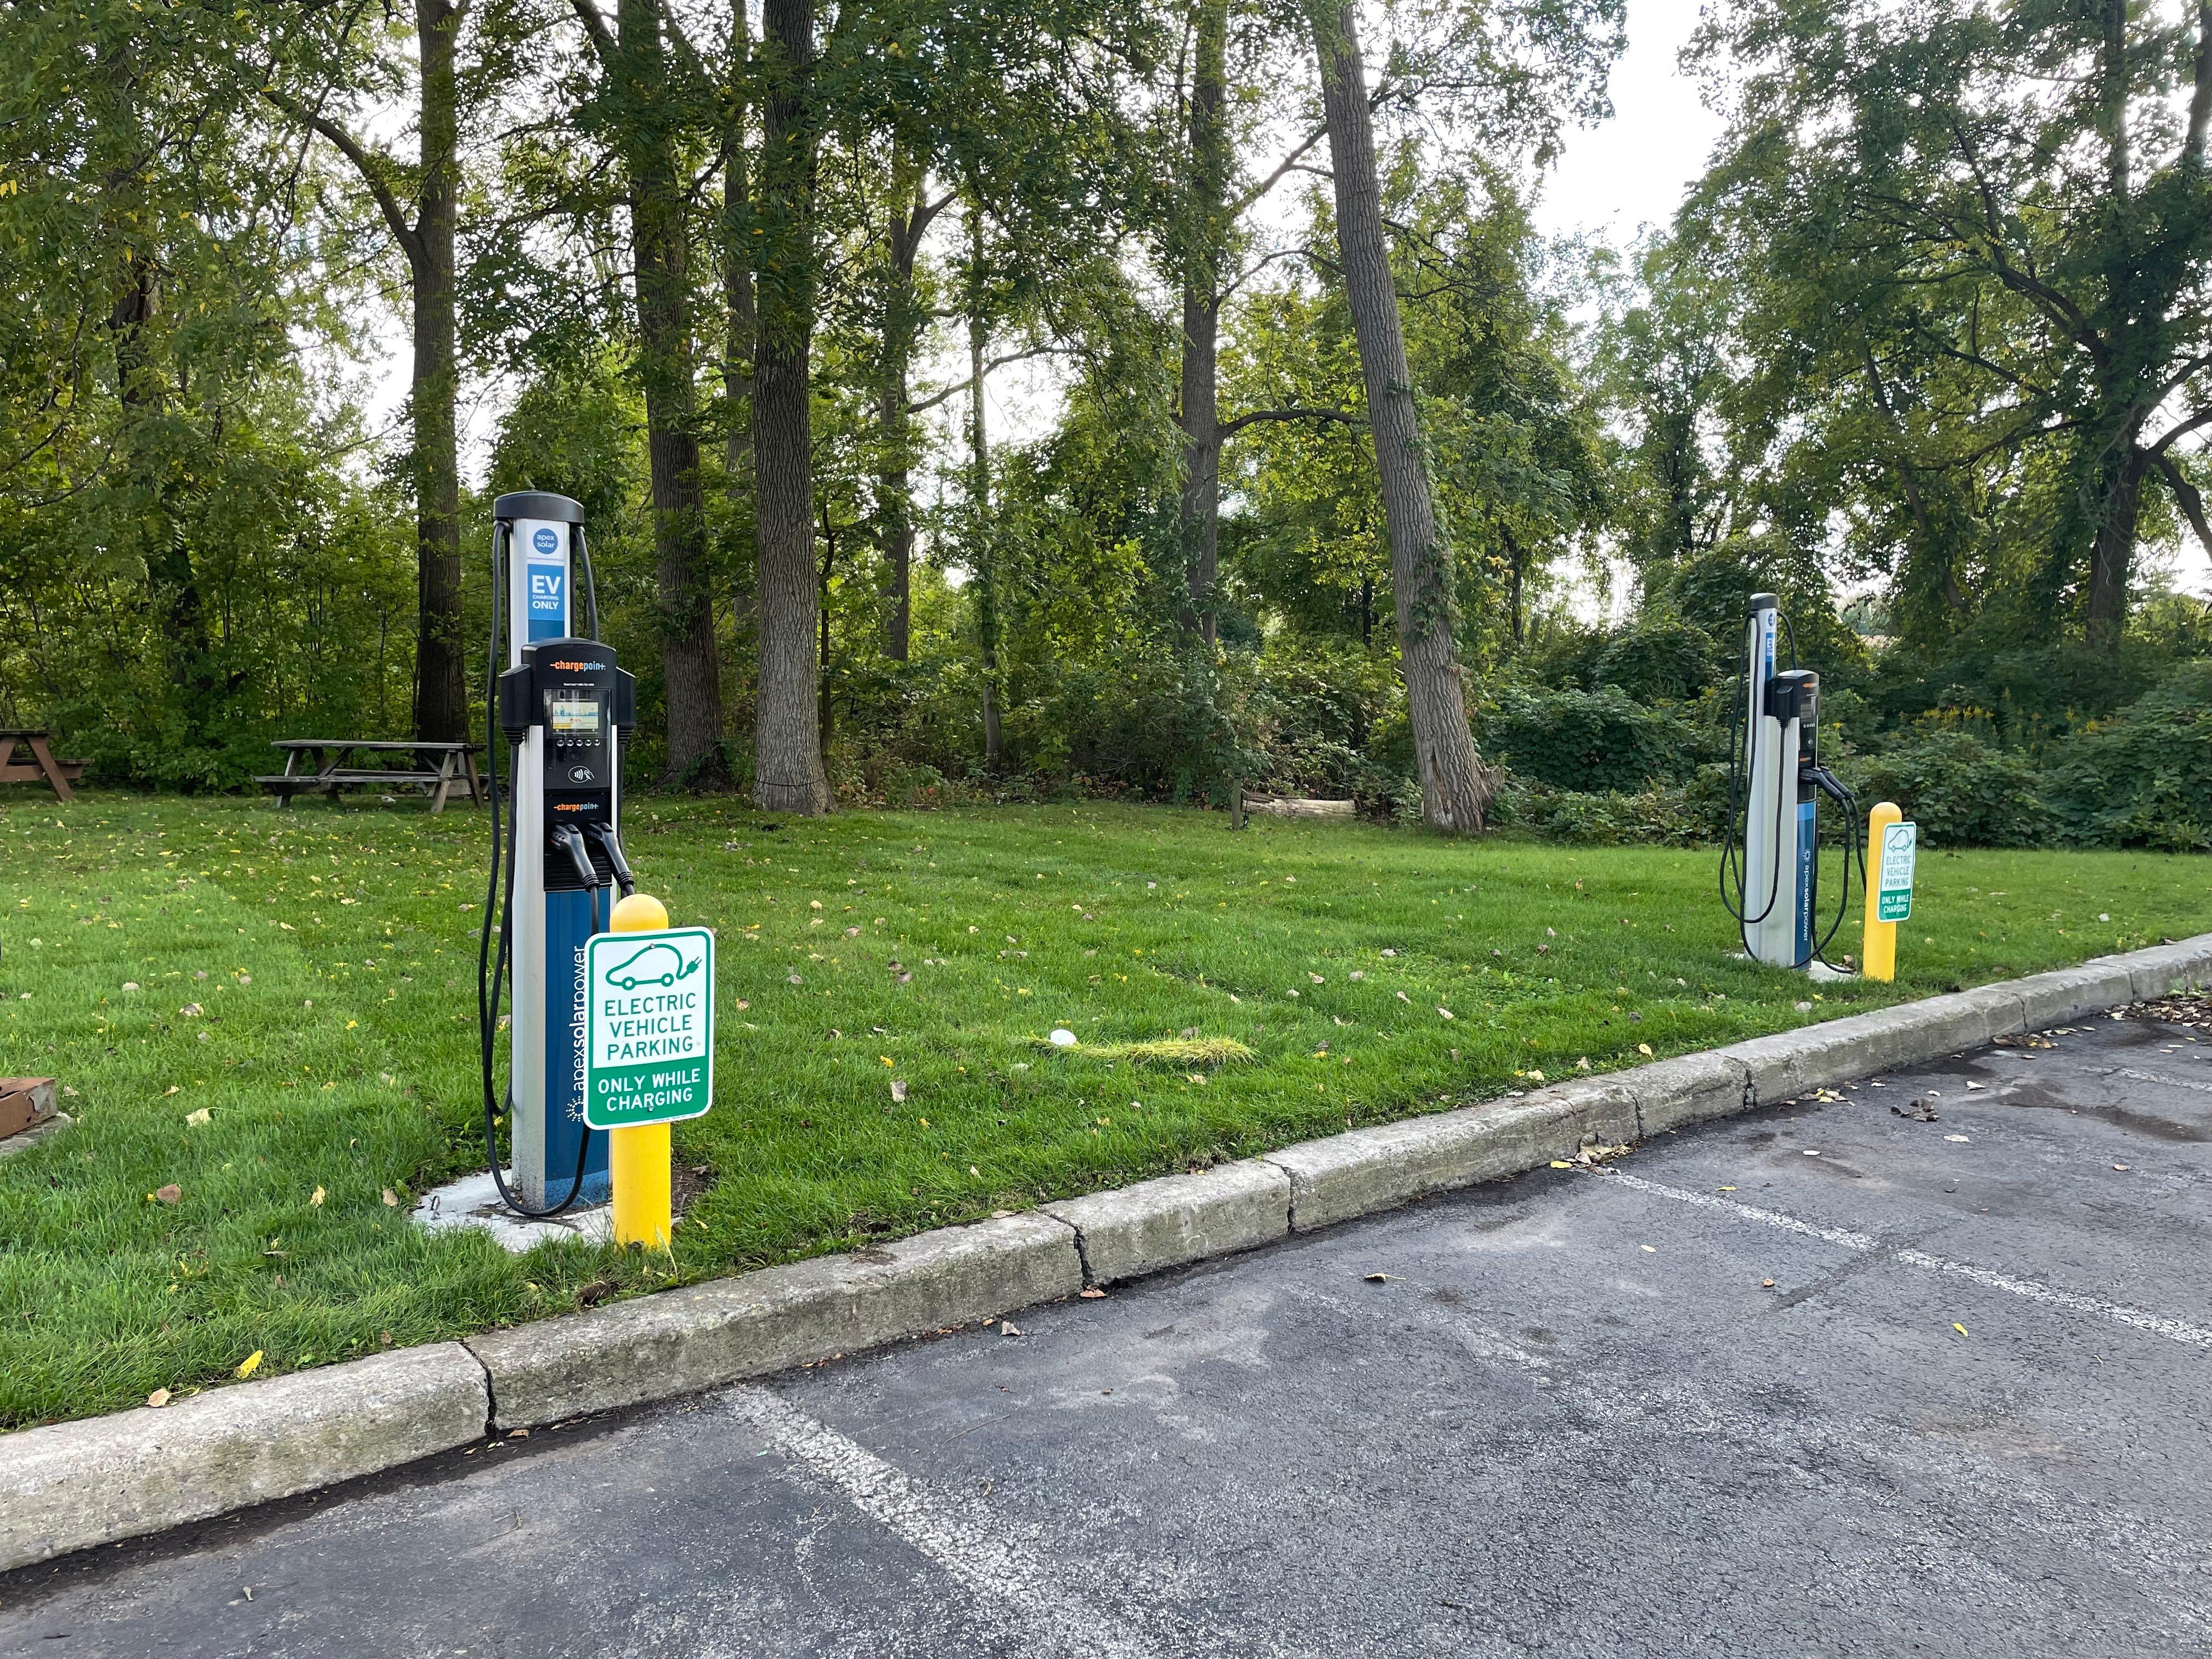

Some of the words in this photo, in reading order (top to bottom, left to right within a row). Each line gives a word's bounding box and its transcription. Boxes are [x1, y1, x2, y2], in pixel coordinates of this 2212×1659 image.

[532, 574, 561, 594] EV
[532, 601, 559, 610] ONLY
[550, 660, 606, 672] chargepoint
[554, 802, 599, 812] chargepoint
[1886, 855, 1911, 865] ELECTRIC
[1887, 866, 1909, 876] VEHICLE
[1886, 877, 1909, 887] PARKING
[1882, 895, 1895, 905] ONLY
[1897, 894, 1909, 904] WHILE
[1883, 904, 1907, 913] CHARGING
[605, 992, 696, 1017] ELECTRIC
[610, 1014, 692, 1038] VEHICLE
[608, 1036, 693, 1060] PARKING
[598, 1075, 646, 1094] ONLY
[652, 1068, 701, 1088] WHILE
[606, 1087, 693, 1111] CHARGING
